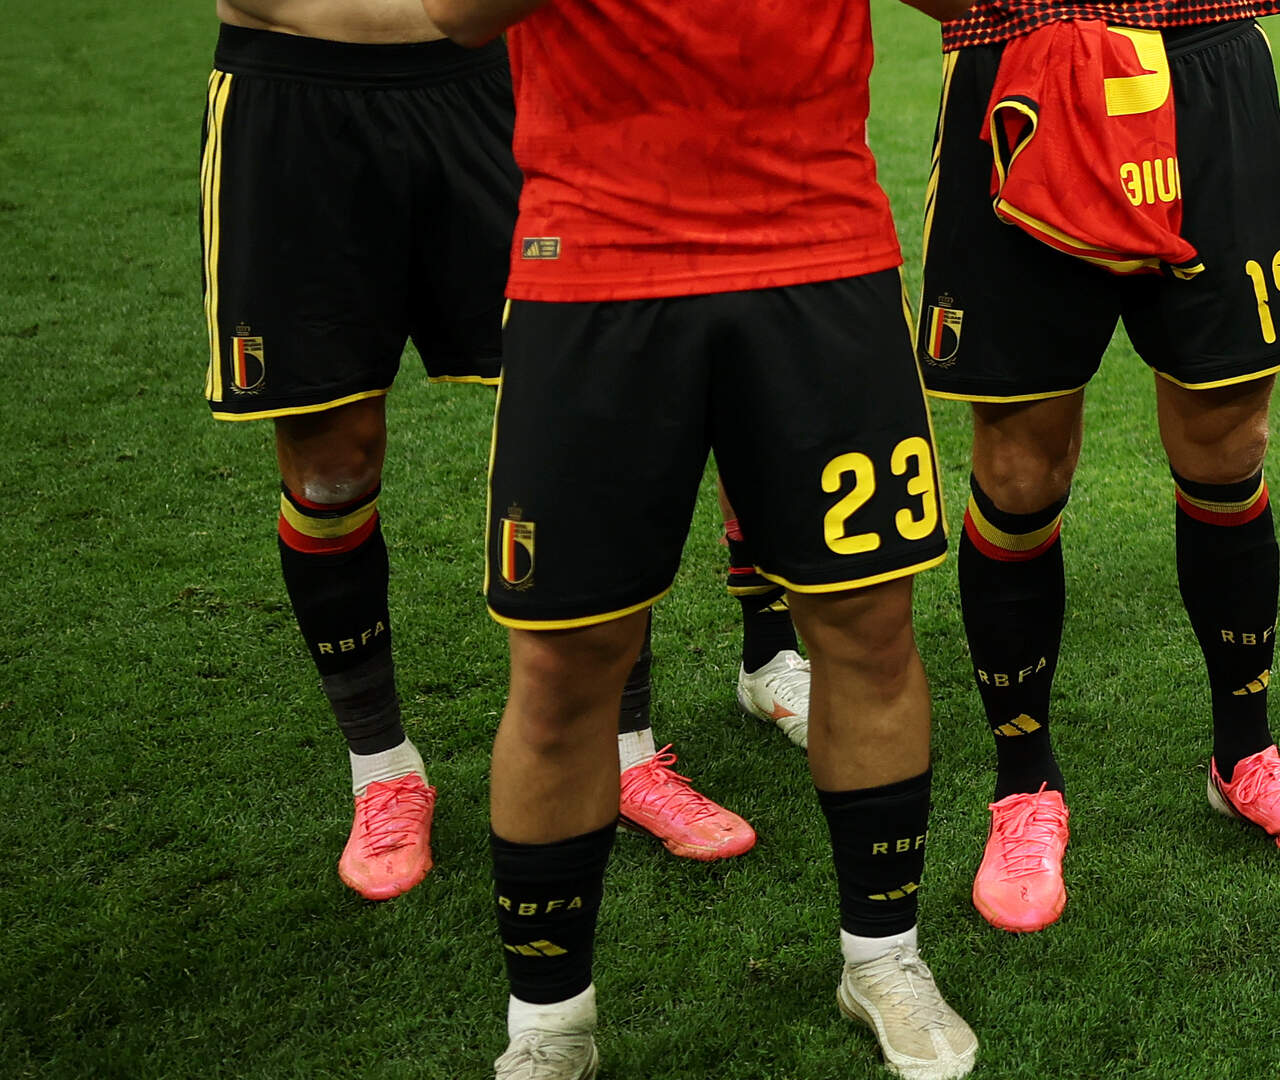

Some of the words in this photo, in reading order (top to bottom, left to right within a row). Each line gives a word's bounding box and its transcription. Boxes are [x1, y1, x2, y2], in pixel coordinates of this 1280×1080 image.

[820, 436, 939, 556] 23
[318, 620, 386, 654] RBFA
[1220, 618, 1278, 647] RBF
[977, 656, 1047, 688] RBFA
[871, 830, 928, 857] RBF
[498, 894, 583, 917] RBFA
